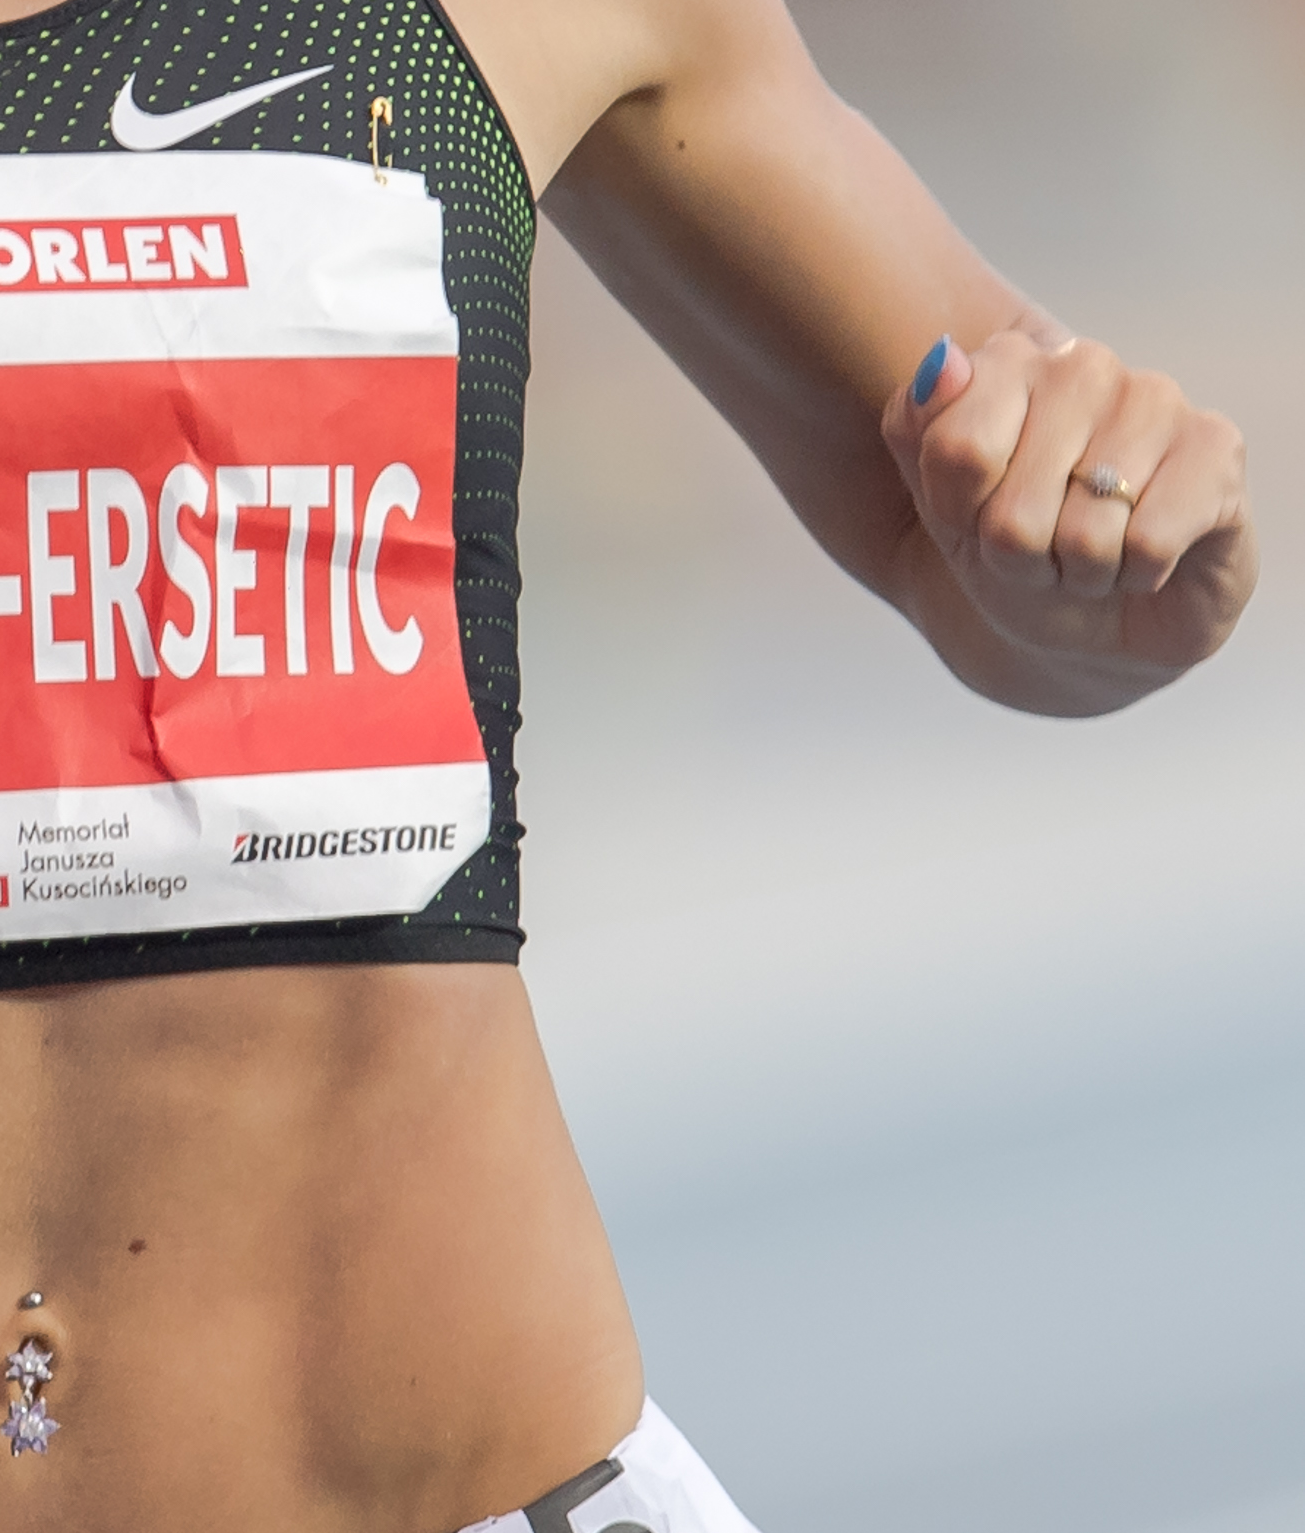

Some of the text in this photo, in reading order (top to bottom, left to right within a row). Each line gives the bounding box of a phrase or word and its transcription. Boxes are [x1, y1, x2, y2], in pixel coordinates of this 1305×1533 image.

[18, 813, 130, 846] Memoriał
[231, 823, 457, 864] BRIDGESTONE
[20, 849, 115, 874] Janusza
[22, 869, 187, 902] Kusocińskiego
